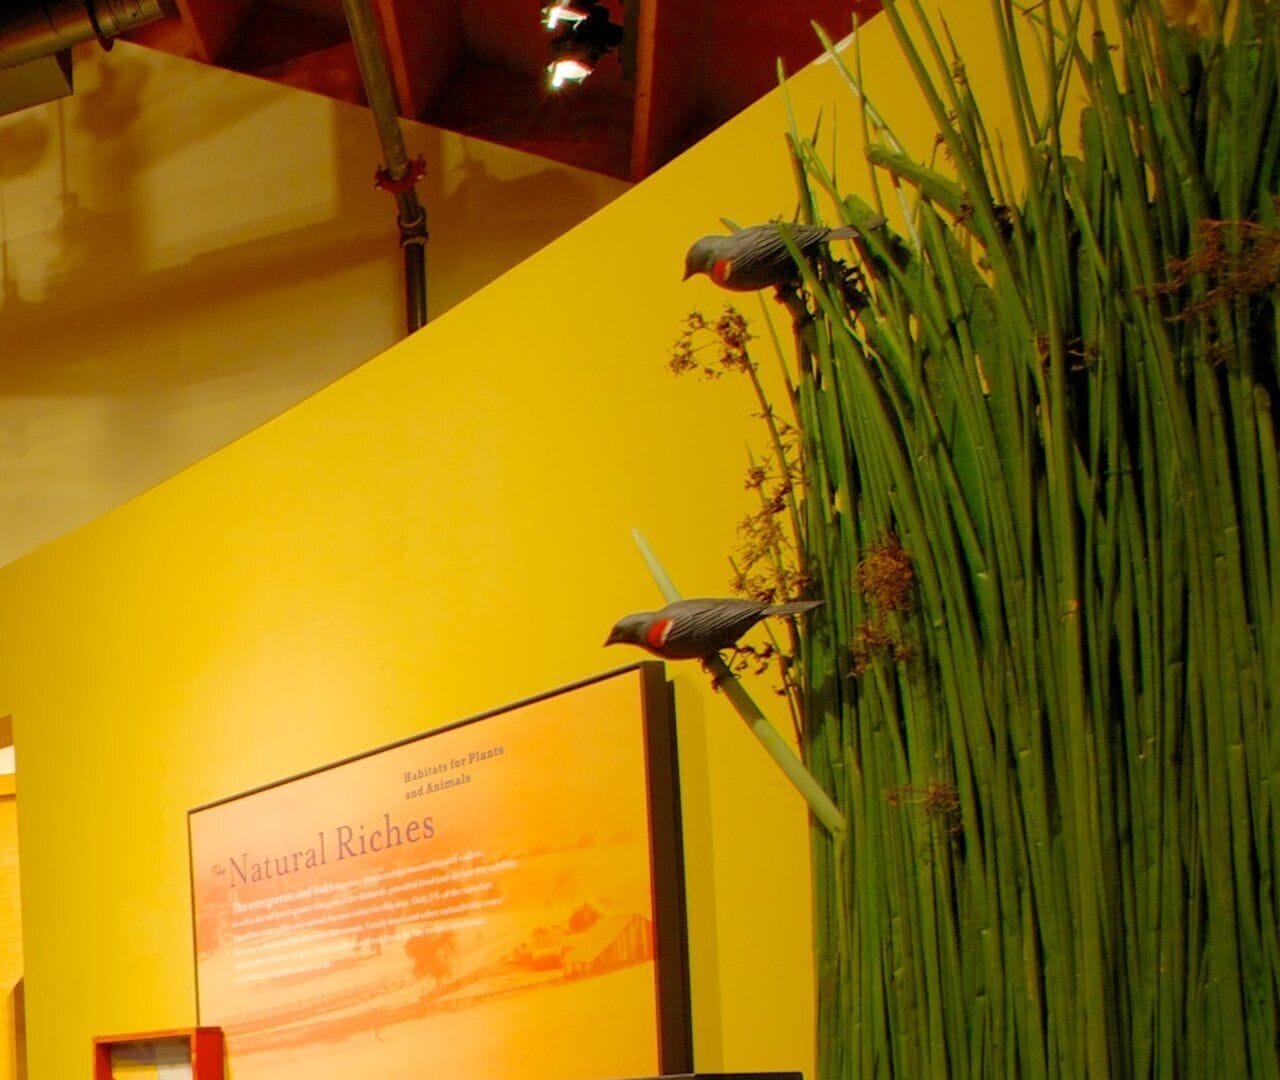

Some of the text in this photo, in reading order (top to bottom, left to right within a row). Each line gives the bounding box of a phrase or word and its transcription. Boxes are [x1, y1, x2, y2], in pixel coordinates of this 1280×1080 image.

[403, 746, 504, 783] Habitats for Plants
[405, 773, 471, 800] and Animals
[229, 831, 328, 888] Natural
[335, 813, 435, 861] Riches
